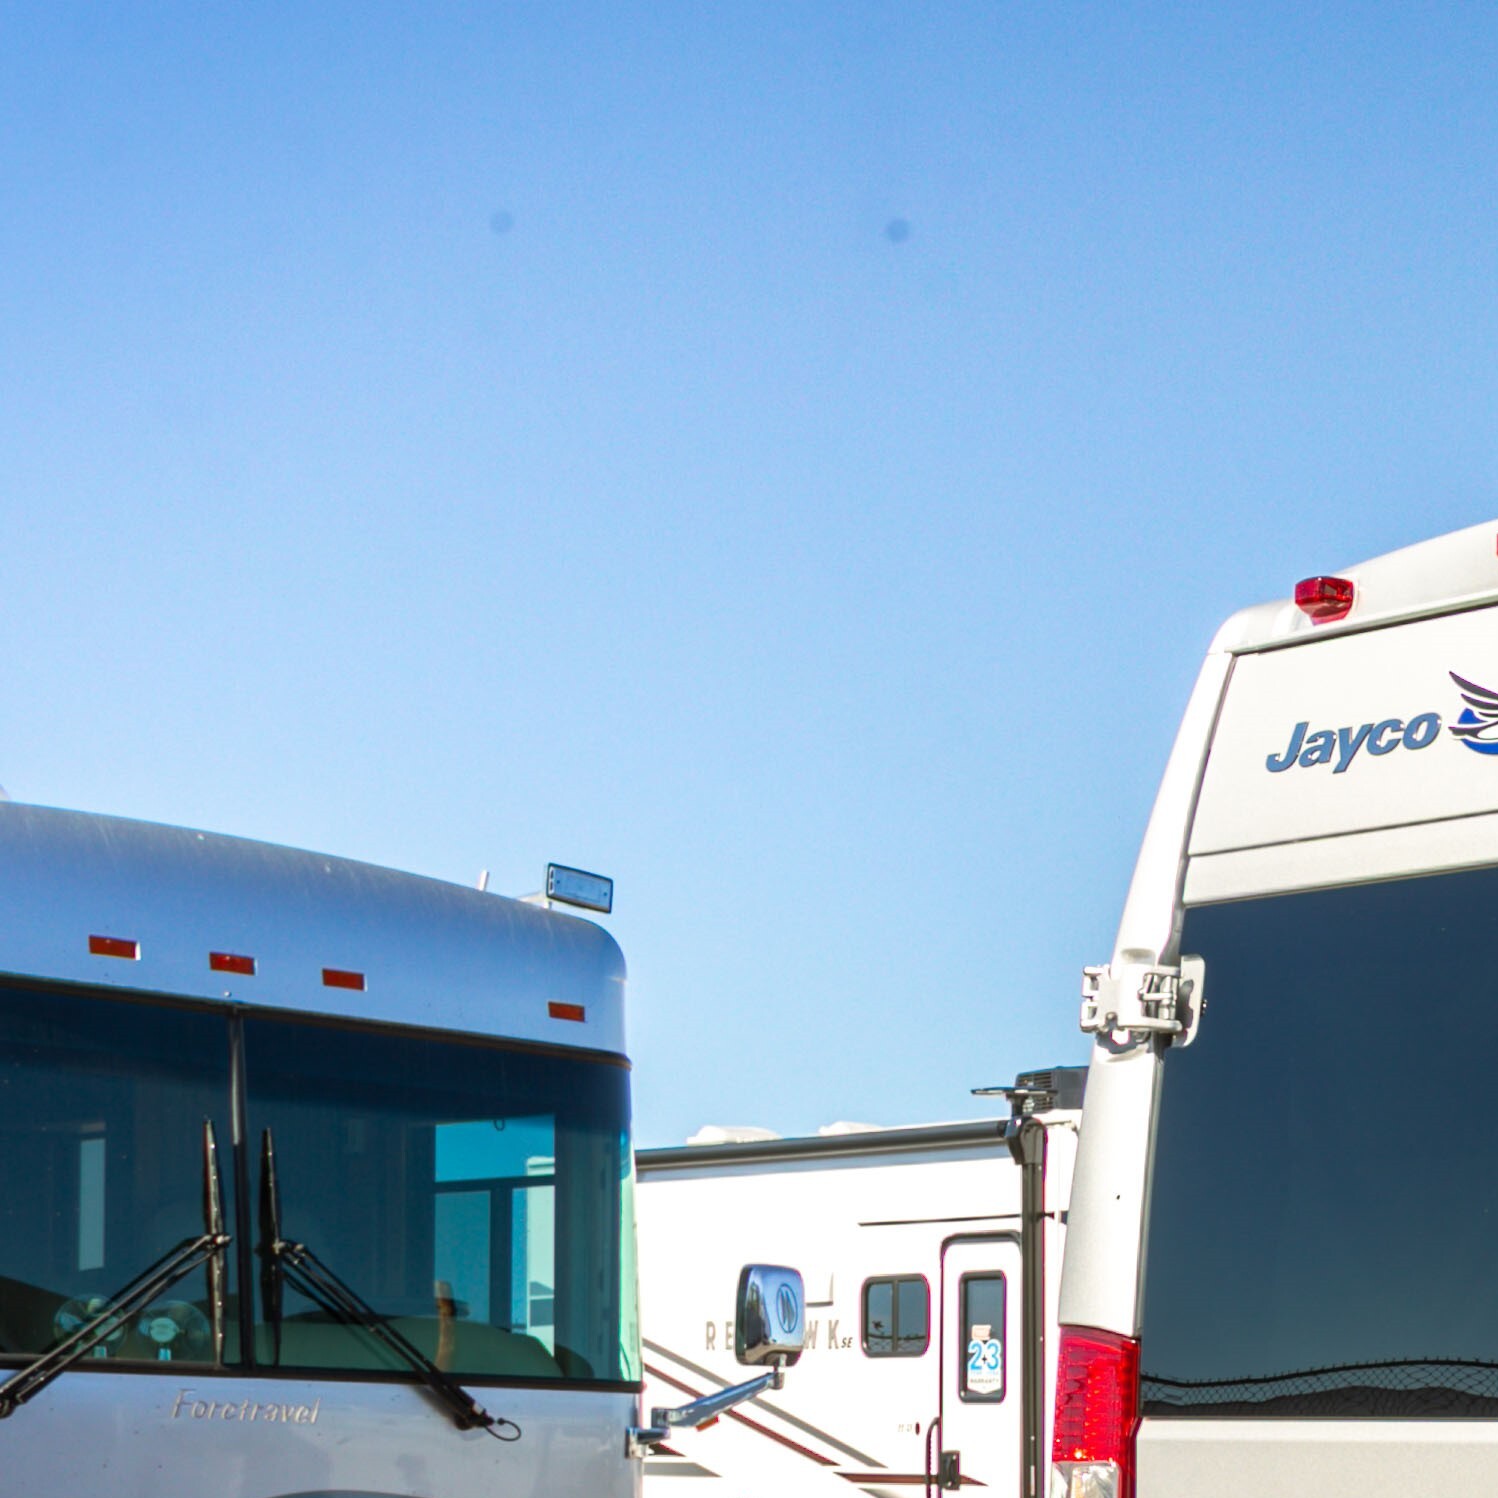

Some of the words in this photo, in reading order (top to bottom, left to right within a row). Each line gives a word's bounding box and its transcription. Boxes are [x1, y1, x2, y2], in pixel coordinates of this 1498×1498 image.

[1265, 712, 1442, 774] Jayco
[705, 1319, 839, 1350] REWK
[171, 1388, 322, 1424] Foretravel
